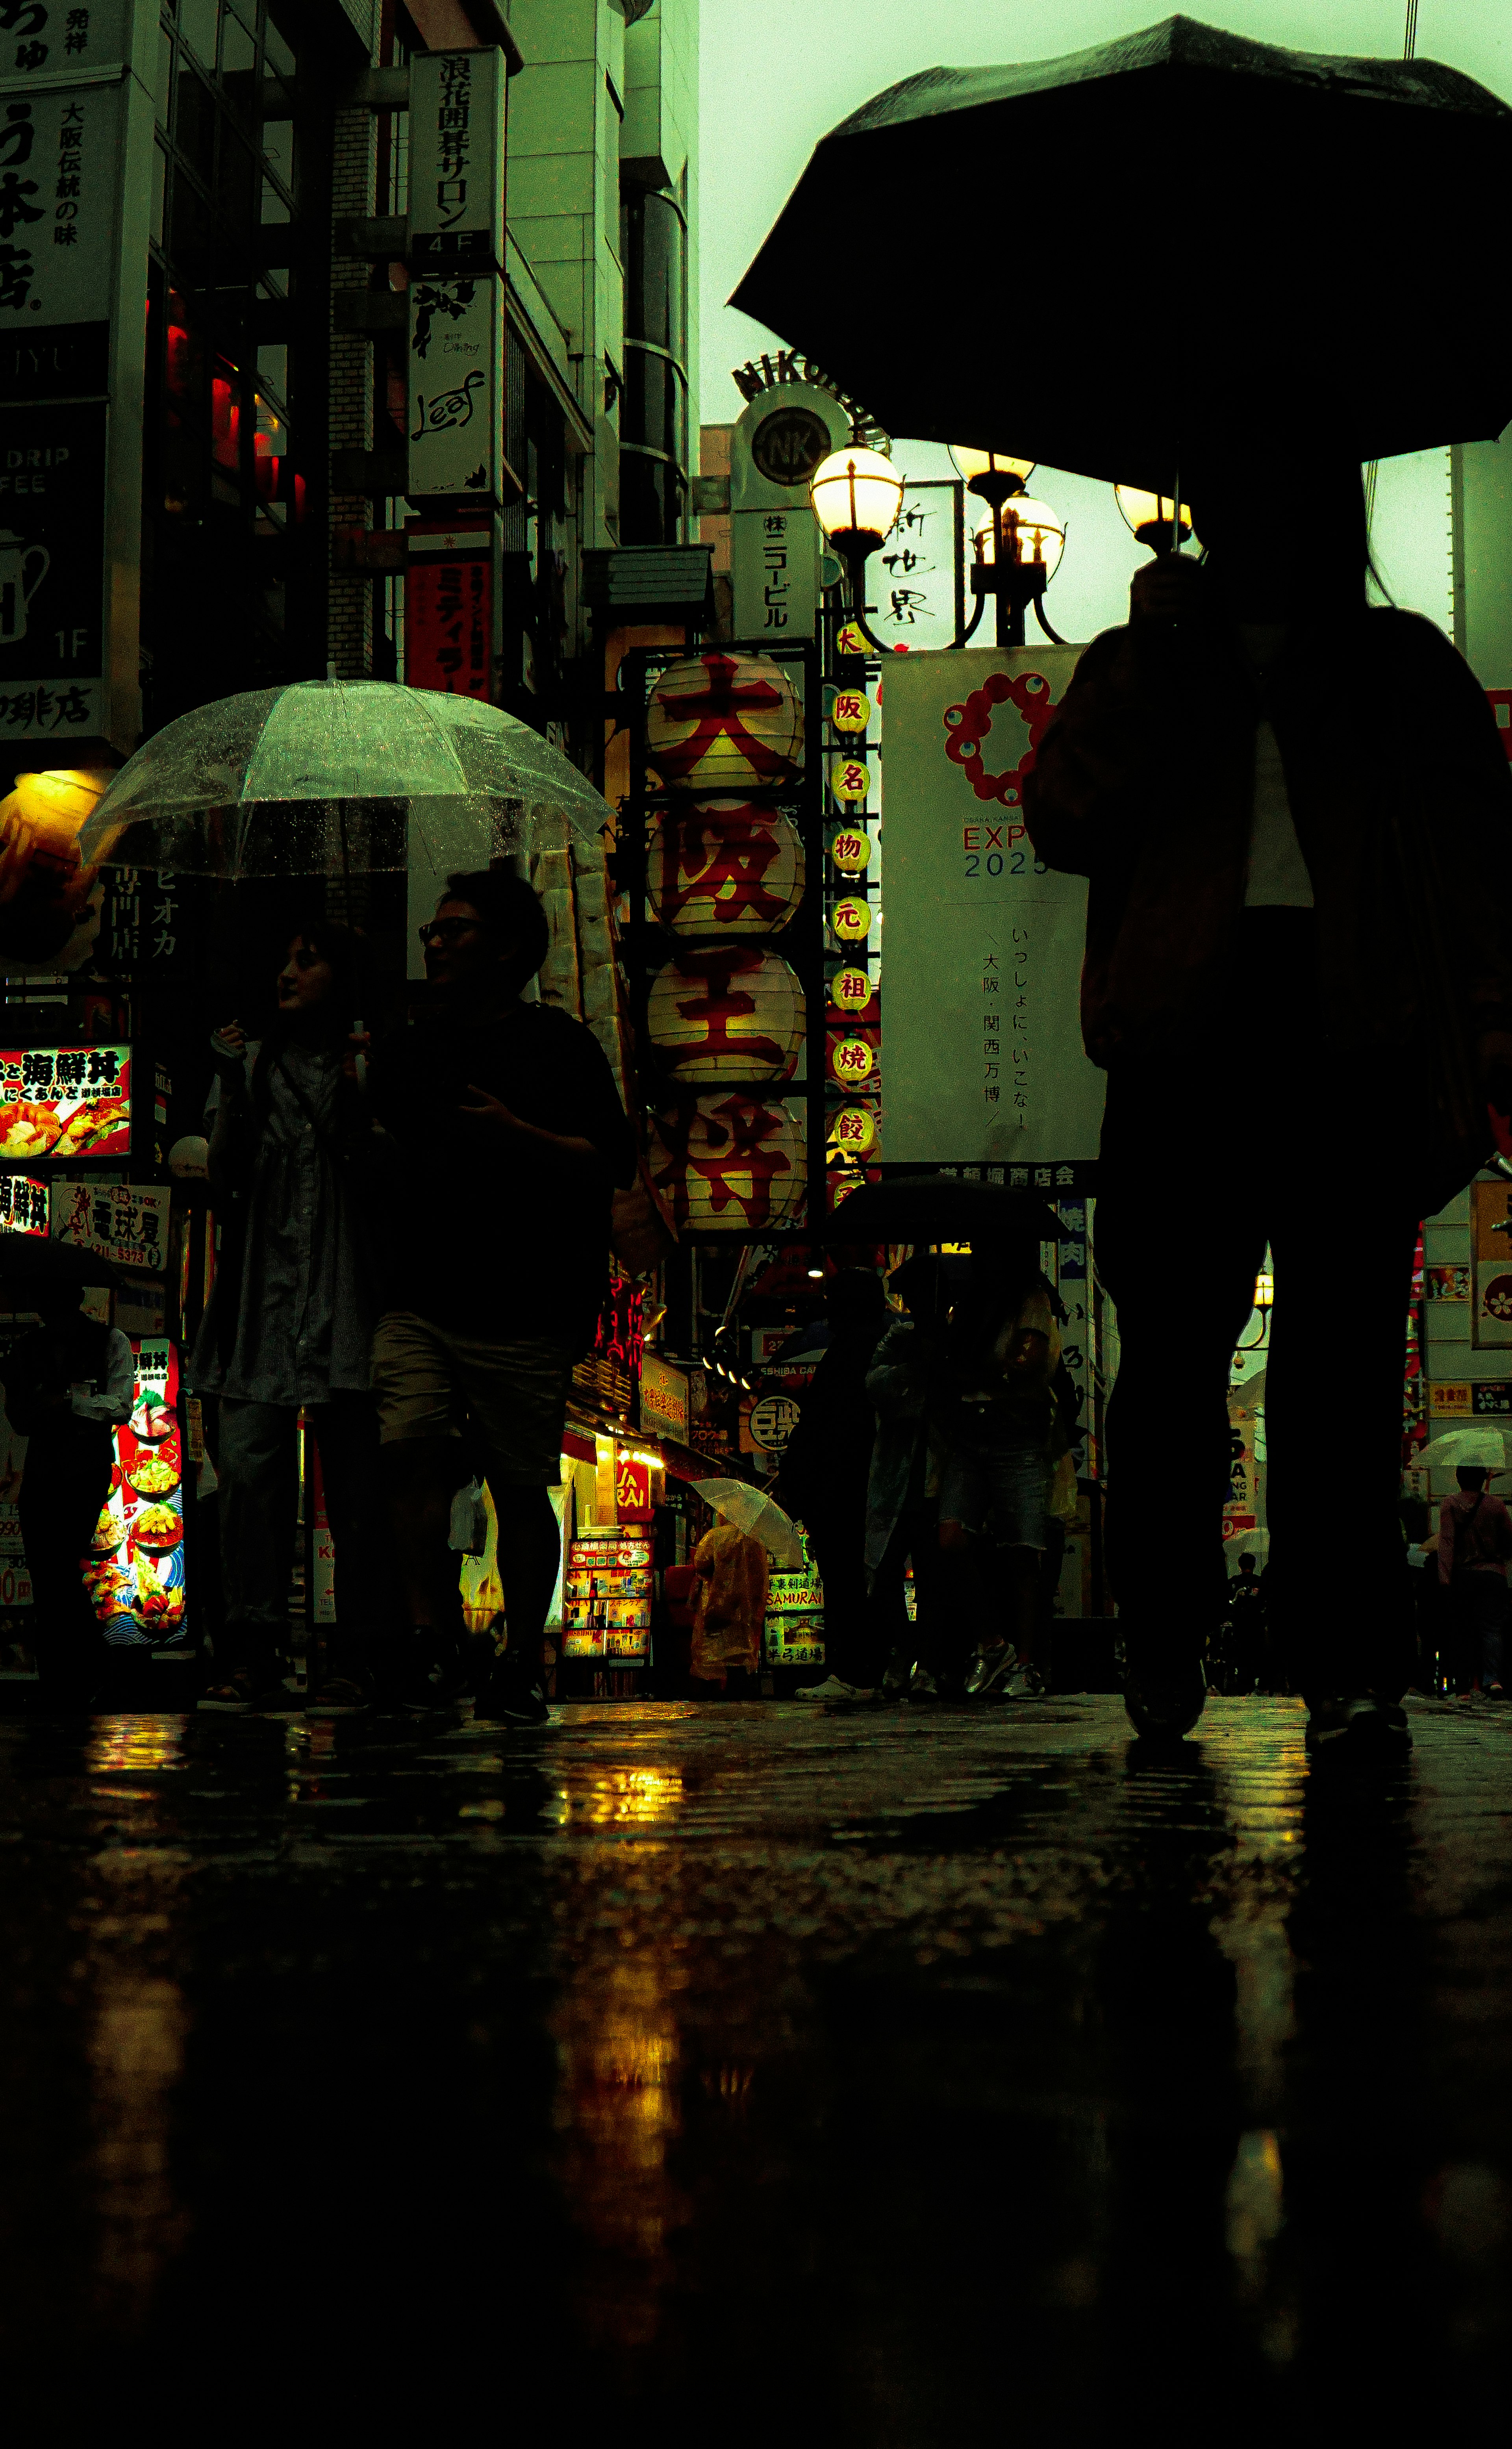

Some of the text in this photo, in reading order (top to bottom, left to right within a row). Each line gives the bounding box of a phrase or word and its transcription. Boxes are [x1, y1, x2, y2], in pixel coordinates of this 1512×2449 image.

[65, 8, 89, 54] 発祥
[437, 57, 471, 229] 浪花囲碁サロン
[54, 102, 84, 246] 大阪伝統の味
[411, 370, 485, 441] Leaf
[6, 447, 70, 469] DRIP
[54, 627, 88, 658] 1F
[964, 825, 1033, 850] EXP
[648, 653, 804, 1227] 大阪王将
[766, 1591, 822, 1605] SAMURAI
